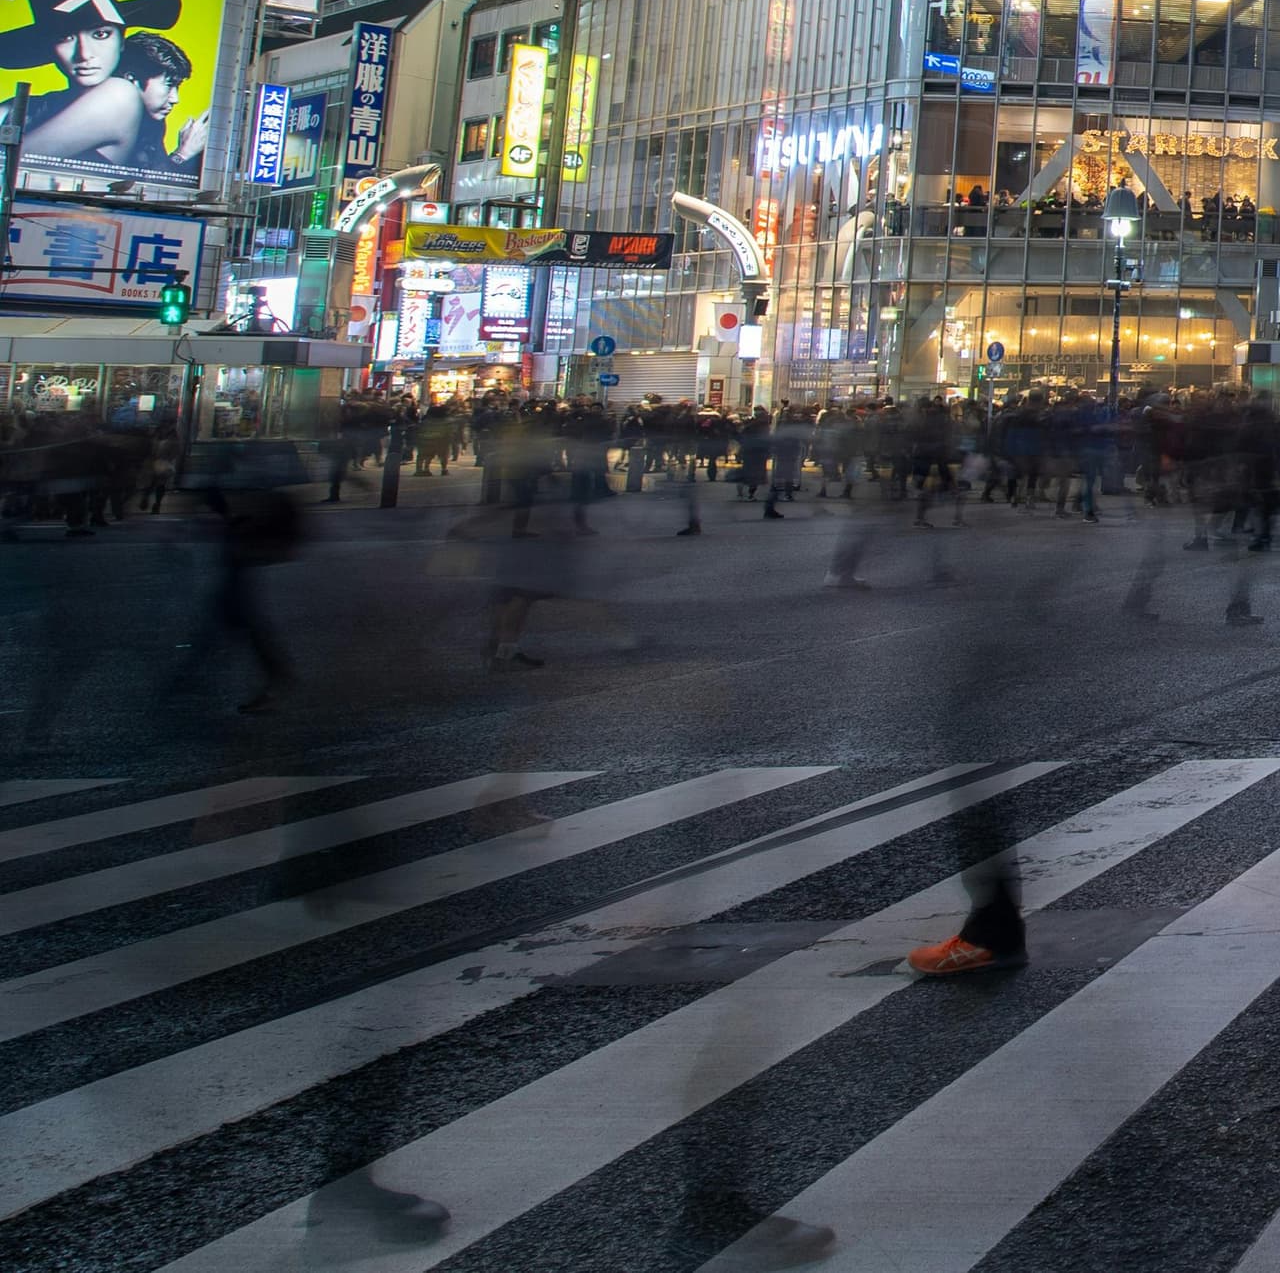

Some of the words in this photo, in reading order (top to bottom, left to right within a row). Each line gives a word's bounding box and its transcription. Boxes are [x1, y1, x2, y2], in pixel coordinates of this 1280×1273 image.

[349, 31, 387, 166] 洋服の青山
[9, 222, 183, 285] 書店
[121, 288, 149, 299] BOOKS
[404, 301, 420, 348] ラーメン
